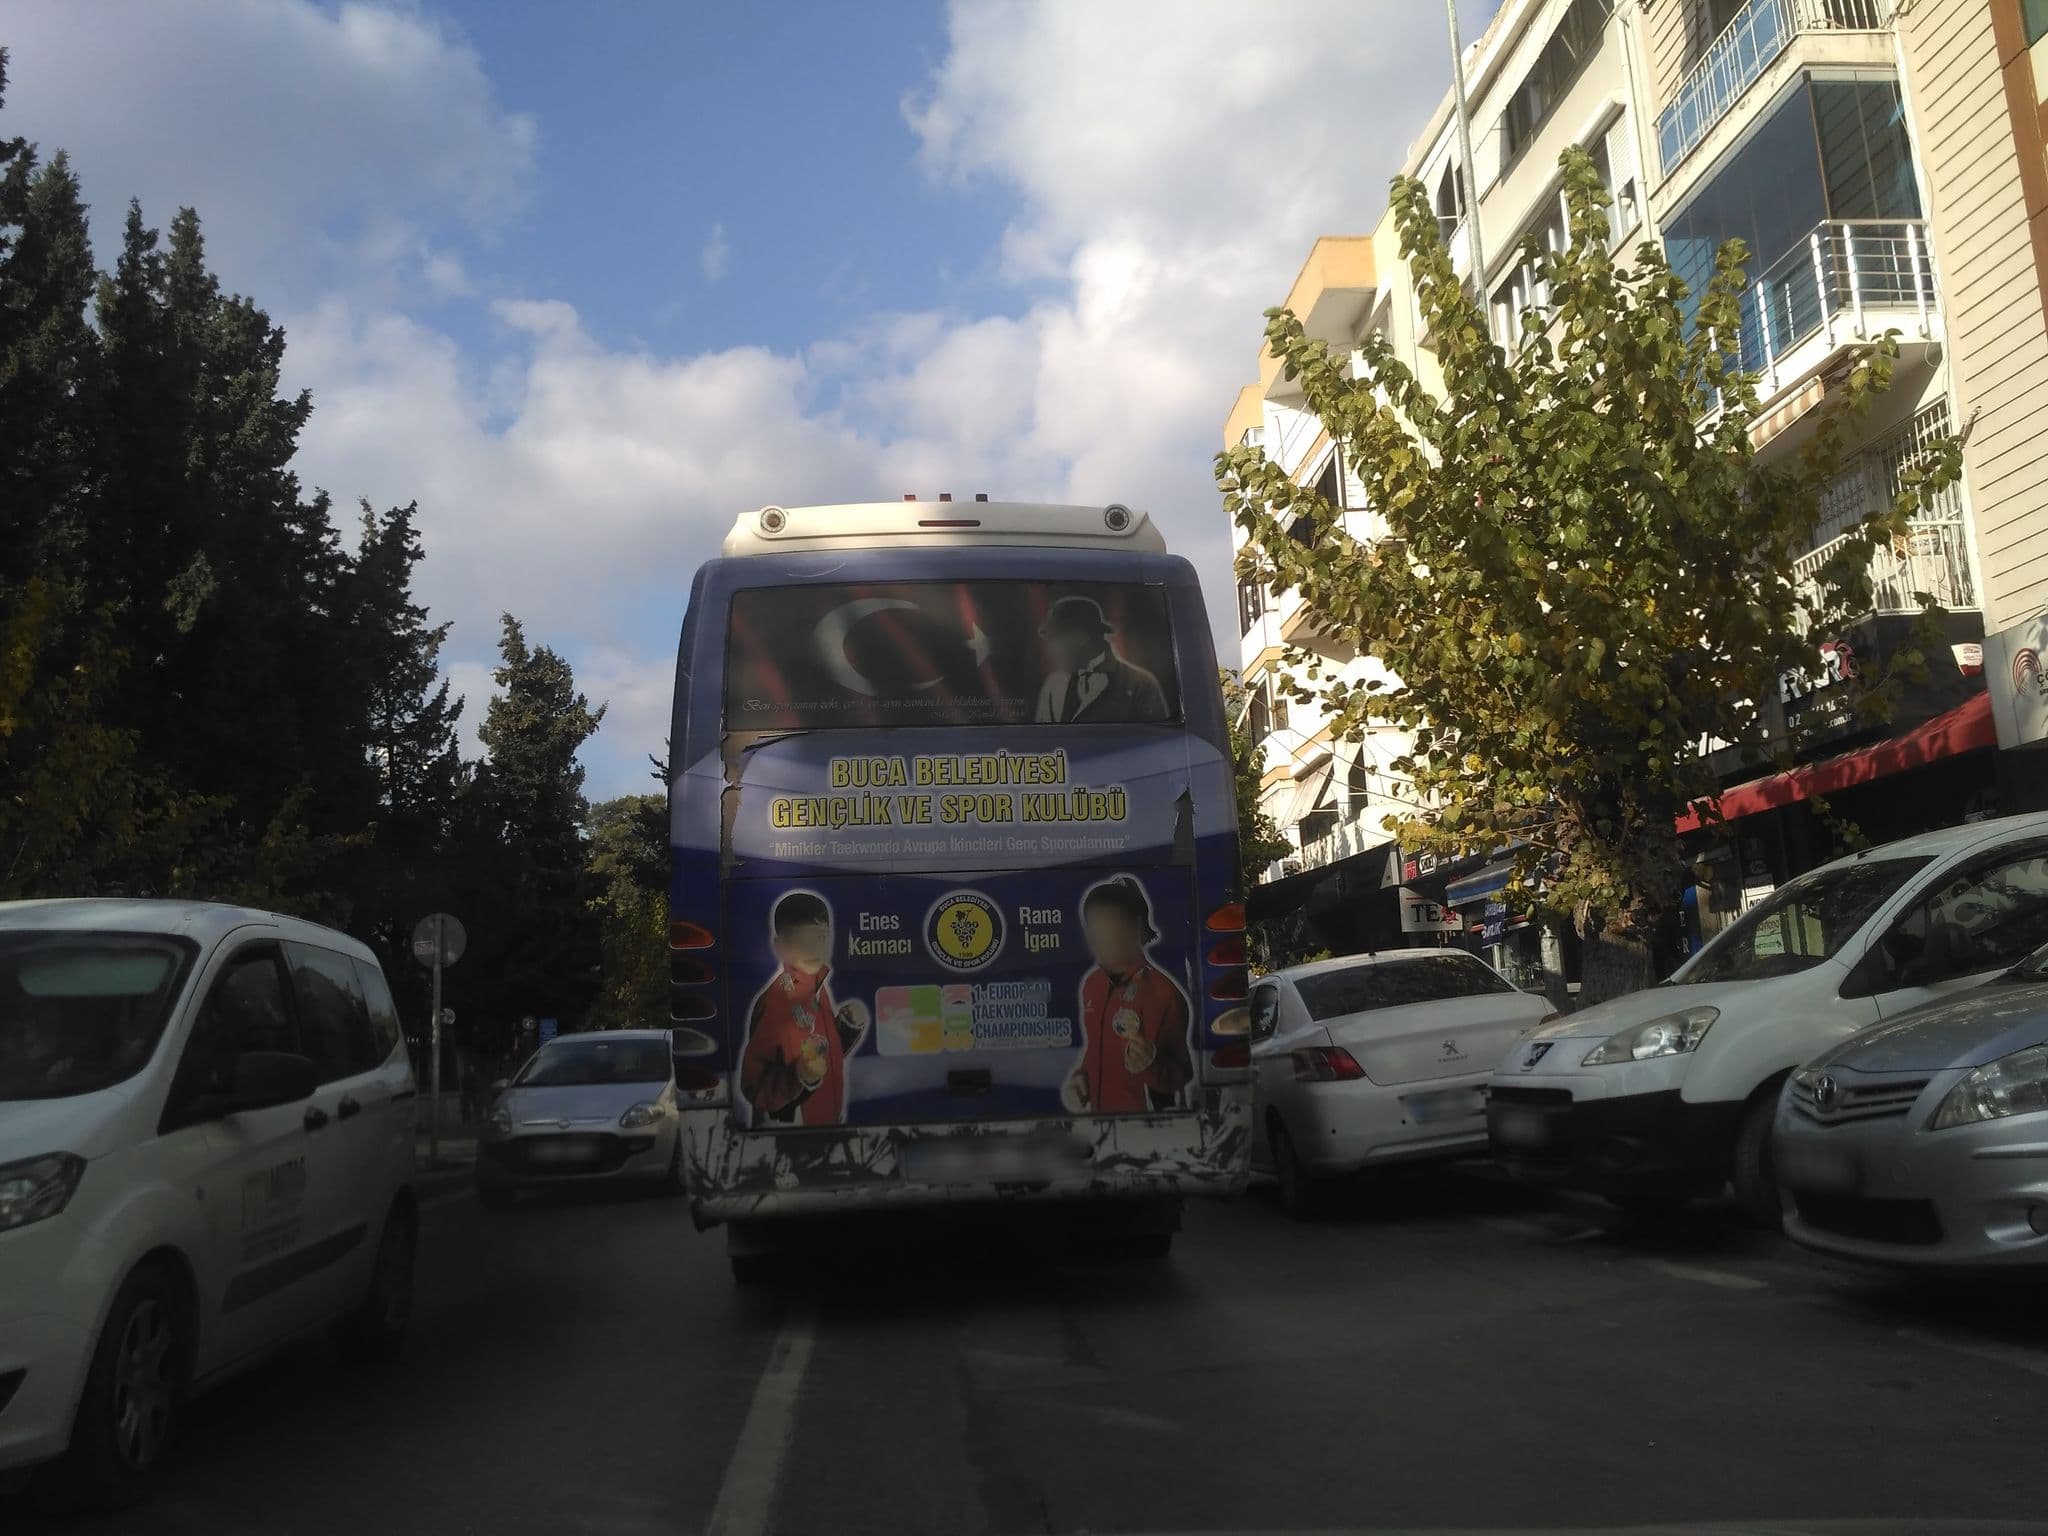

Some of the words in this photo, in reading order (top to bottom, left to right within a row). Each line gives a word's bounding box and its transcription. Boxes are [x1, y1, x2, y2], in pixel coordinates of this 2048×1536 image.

[832, 758, 907, 787] BUCA
[915, 750, 1065, 786] BELEDİYESİ
[772, 791, 892, 830] GENÇLİK
[898, 795, 932, 824] VE
[940, 794, 1013, 822] SPOR
[1021, 787, 1126, 822] KULÜBÜ
[829, 839, 900, 856] Taekwondo
[903, 838, 946, 854] Avrupa
[1006, 836, 1038, 853] Genç
[859, 912, 900, 931] Enes
[1019, 906, 1062, 925] Rana
[848, 936, 912, 955] Kamacı
[1024, 926, 1060, 953] İgan
[974, 1002, 1047, 1020] TAEKWONDO
[975, 1018, 1071, 1039] CHAMPIONSHIPS
